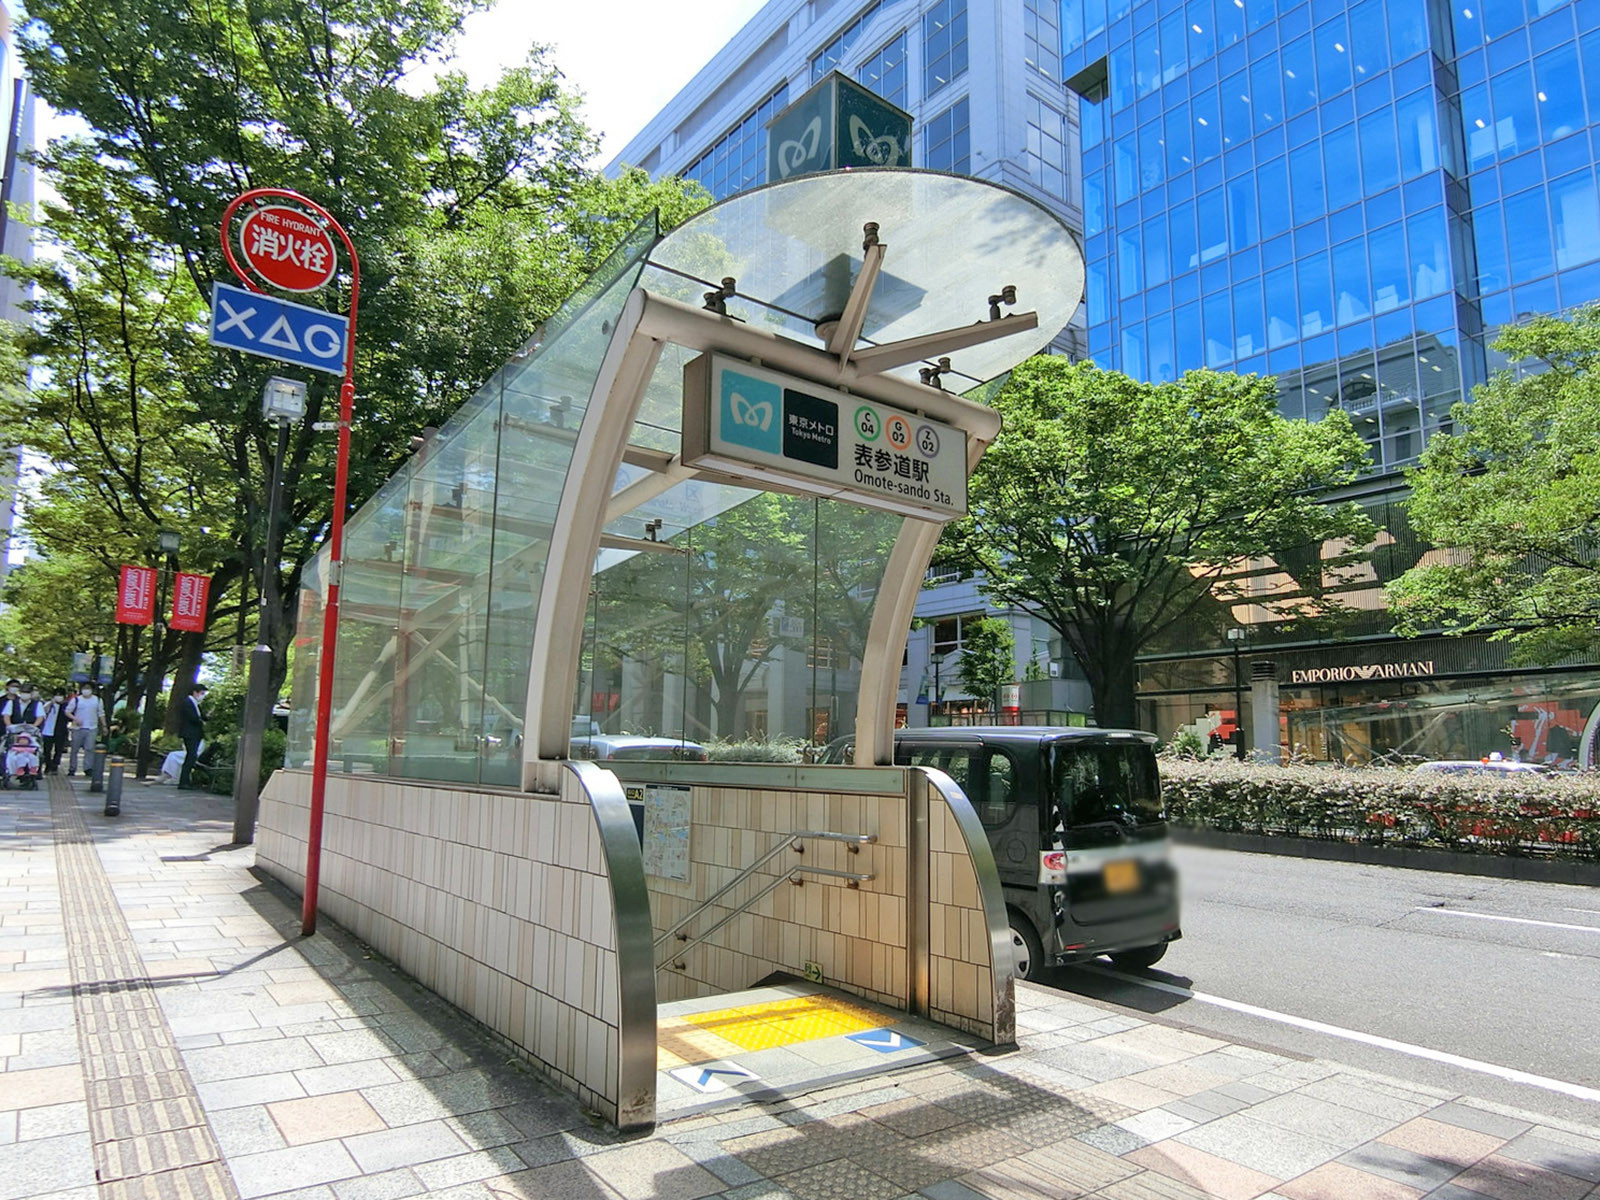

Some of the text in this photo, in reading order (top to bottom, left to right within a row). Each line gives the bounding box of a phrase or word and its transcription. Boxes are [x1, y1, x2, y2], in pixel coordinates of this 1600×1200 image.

[260, 212, 321, 237] FIRE HYDRANT
[251, 223, 329, 274] 消火栓
[788, 413, 834, 436] 東京メトロ
[864, 412, 871, 422] C
[895, 421, 902, 431] G
[791, 426, 831, 445] Tokyo Metro
[861, 422, 874, 434] 04
[892, 431, 905, 443] 02
[925, 430, 931, 440] Z
[922, 440, 934, 452] 02
[854, 443, 929, 484] 表参道駅
[854, 468, 954, 506] Omote-sando Sta.
[1292, 661, 1434, 683] EMPORIO ARMANI
